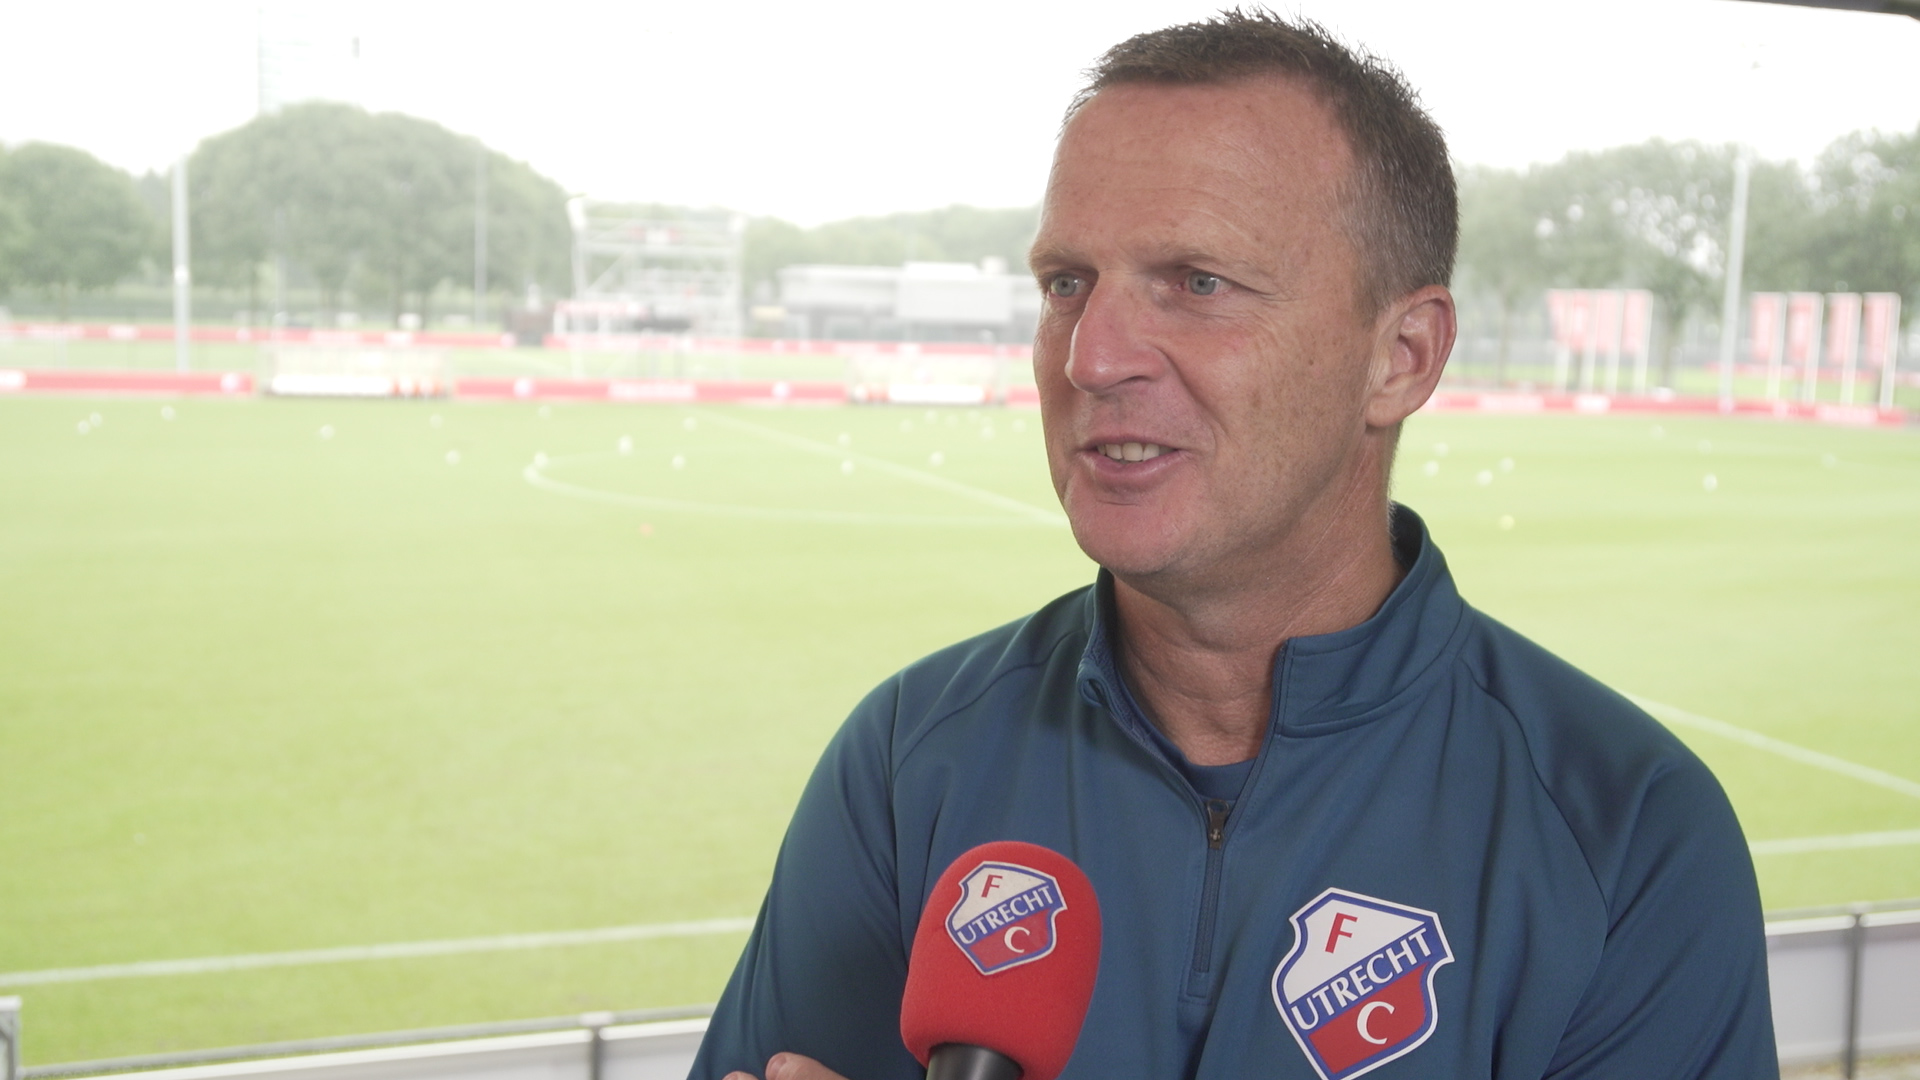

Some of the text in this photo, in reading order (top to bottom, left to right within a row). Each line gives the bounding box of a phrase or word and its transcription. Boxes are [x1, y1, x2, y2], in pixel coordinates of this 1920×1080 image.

[980, 874, 1003, 898] F
[957, 885, 1053, 945] UTRECHT
[1325, 912, 1358, 954] F
[1004, 926, 1030, 953] C
[1291, 928, 1431, 1030] UTRECHT
[1356, 1001, 1395, 1045] C
